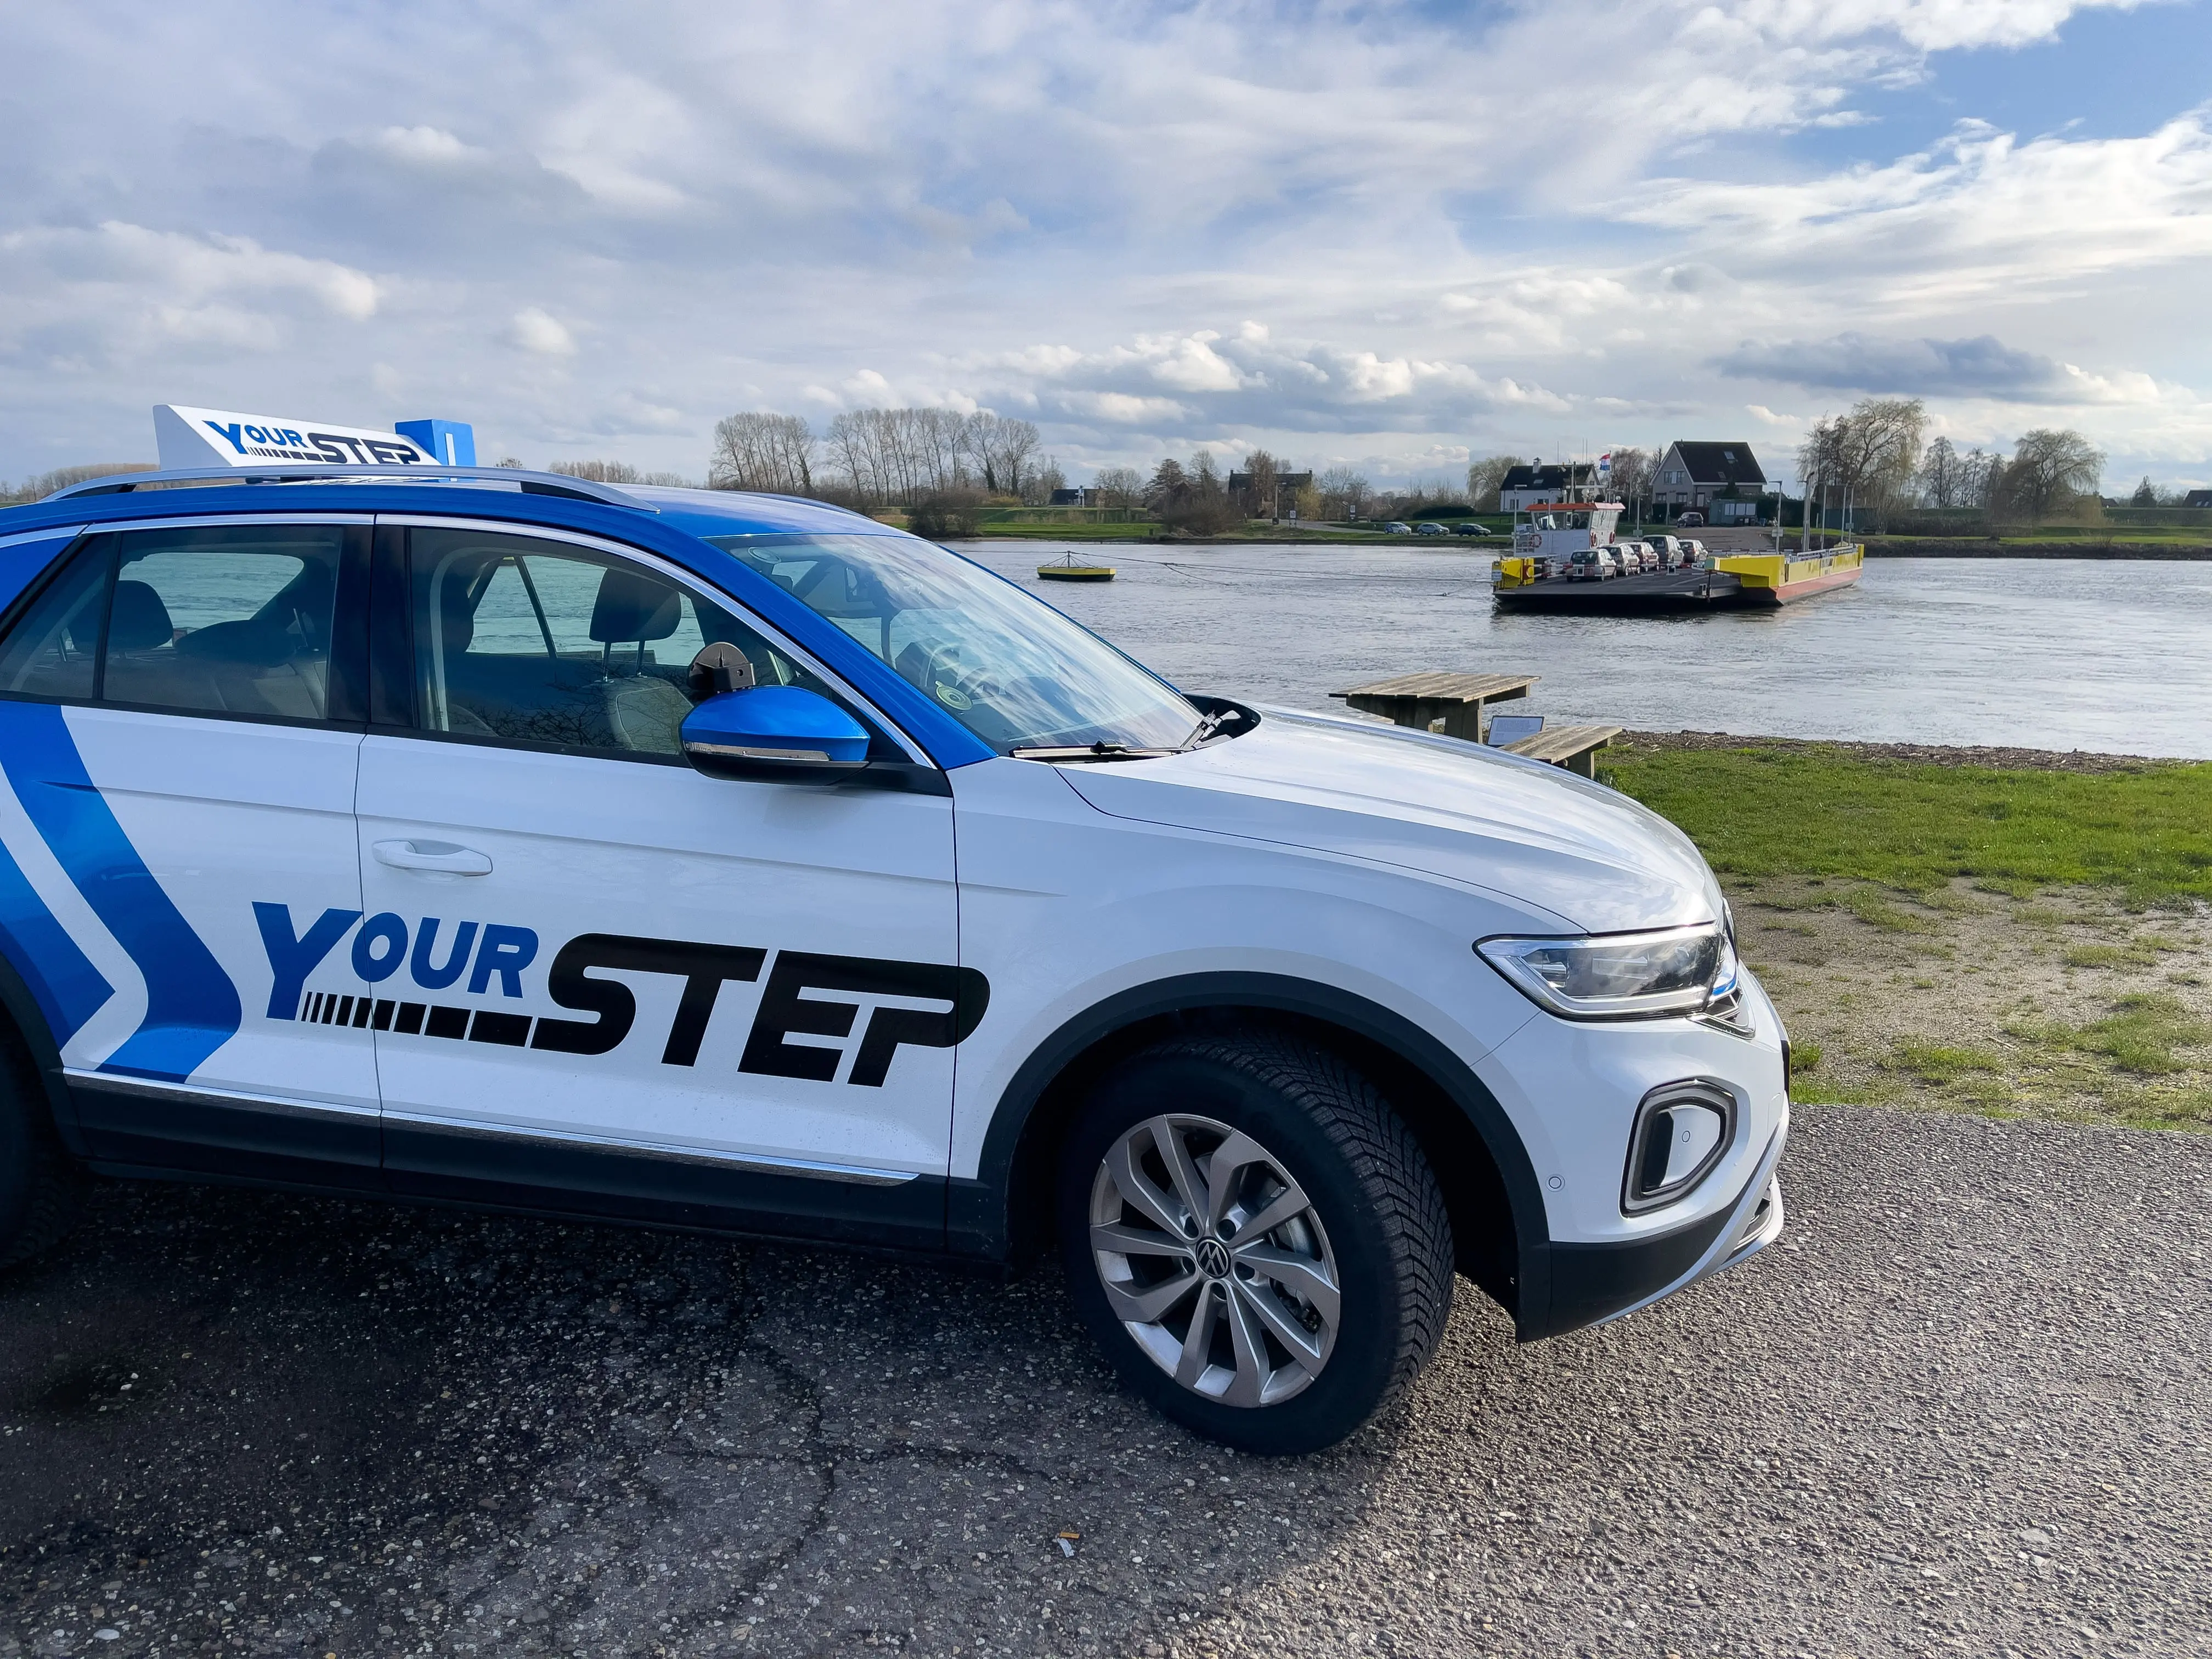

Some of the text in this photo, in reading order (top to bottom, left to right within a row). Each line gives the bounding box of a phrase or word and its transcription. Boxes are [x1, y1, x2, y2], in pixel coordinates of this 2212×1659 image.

[202, 420, 309, 454] YOUR
[307, 432, 420, 464] STEP
[251, 901, 991, 1088] YOUR STEP
